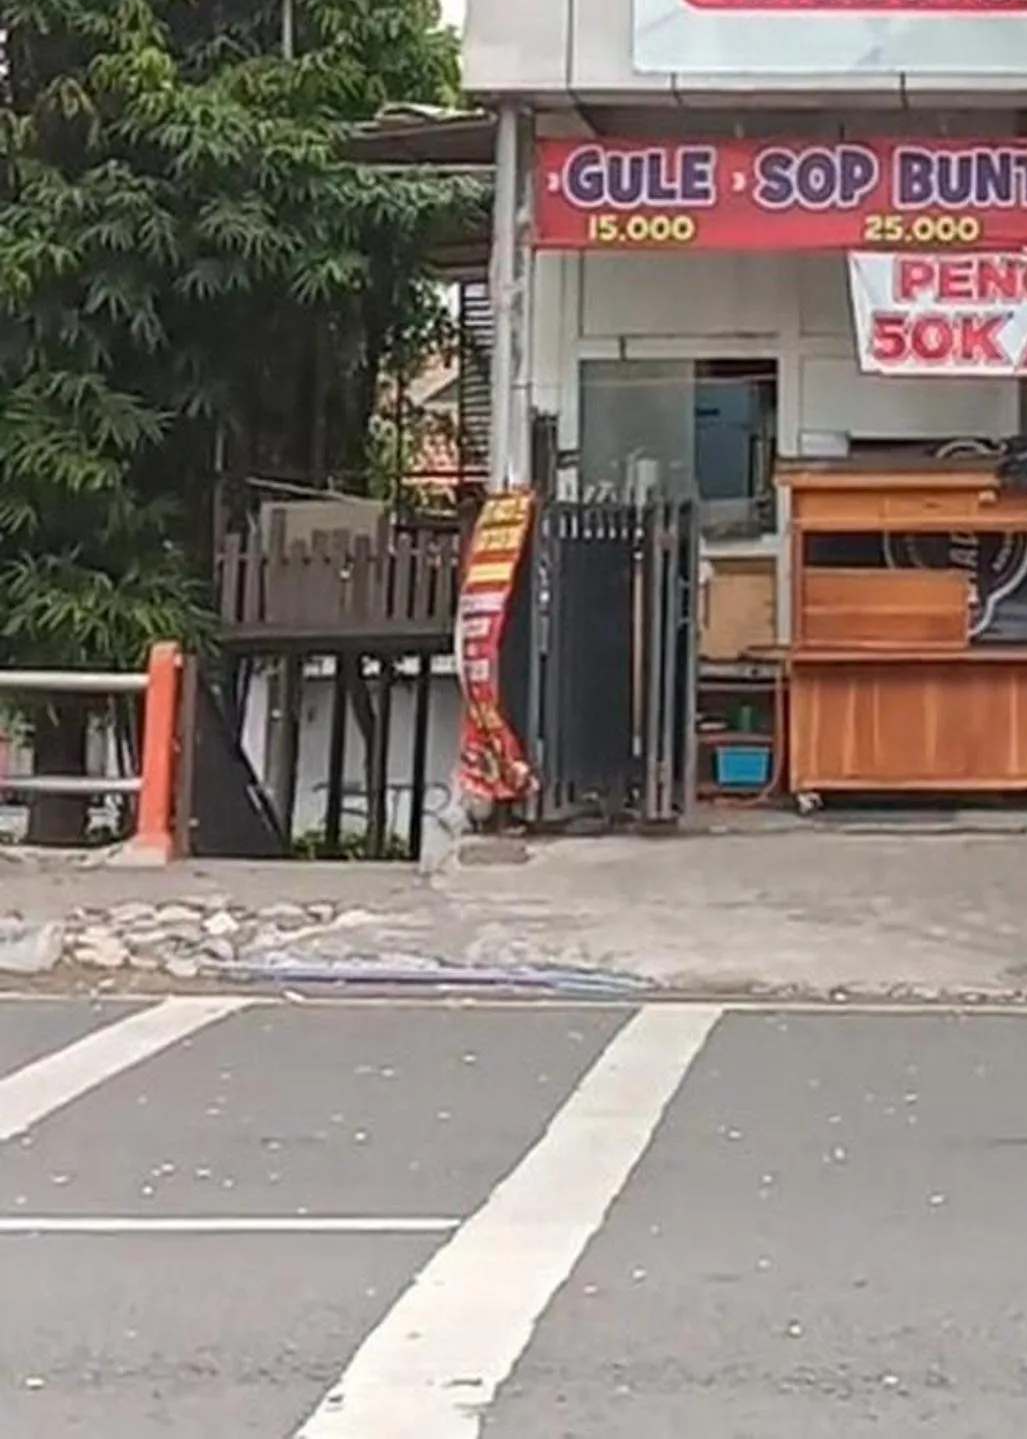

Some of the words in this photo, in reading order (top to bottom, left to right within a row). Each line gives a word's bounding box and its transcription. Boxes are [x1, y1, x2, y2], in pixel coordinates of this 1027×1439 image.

[565, 147, 714, 206] GULE
[755, 147, 876, 207] SOP
[588, 214, 696, 242] 15.000
[862, 214, 980, 243] 25.000
[870, 313, 1012, 363] 50K
